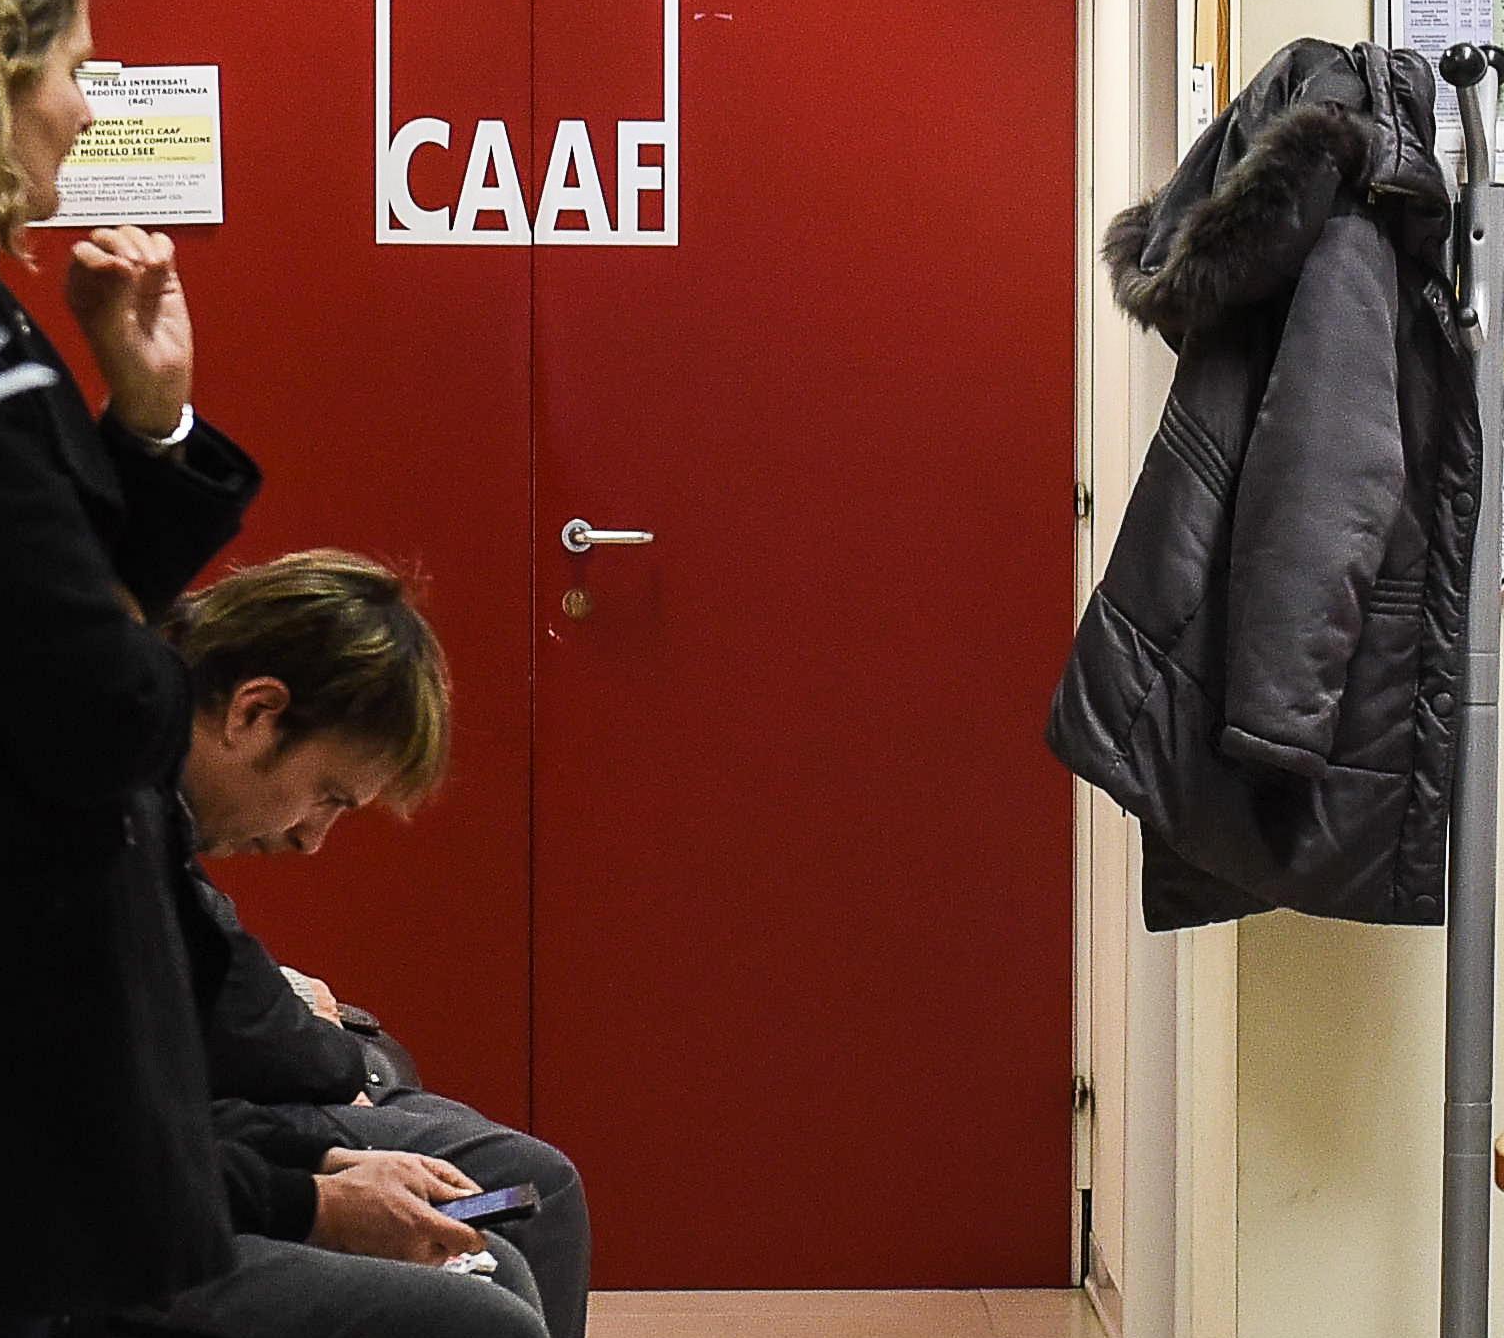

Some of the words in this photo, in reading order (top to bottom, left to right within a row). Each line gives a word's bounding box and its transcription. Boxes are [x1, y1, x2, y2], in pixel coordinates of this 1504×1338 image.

[111, 79, 127, 87] GLI
[86, 89, 126, 97] REDDITO
[128, 88, 139, 96] DI
[141, 87, 208, 95] CITTADINANZA
[124, 128, 155, 136] UFFICI
[157, 127, 181, 135] CAAF
[118, 137, 141, 145] SOLA
[143, 136, 211, 144] COMPILAZIONE
[80, 148, 129, 157] MODELLO
[132, 147, 156, 156] ISEE
[388, 116, 665, 233] CAAF
